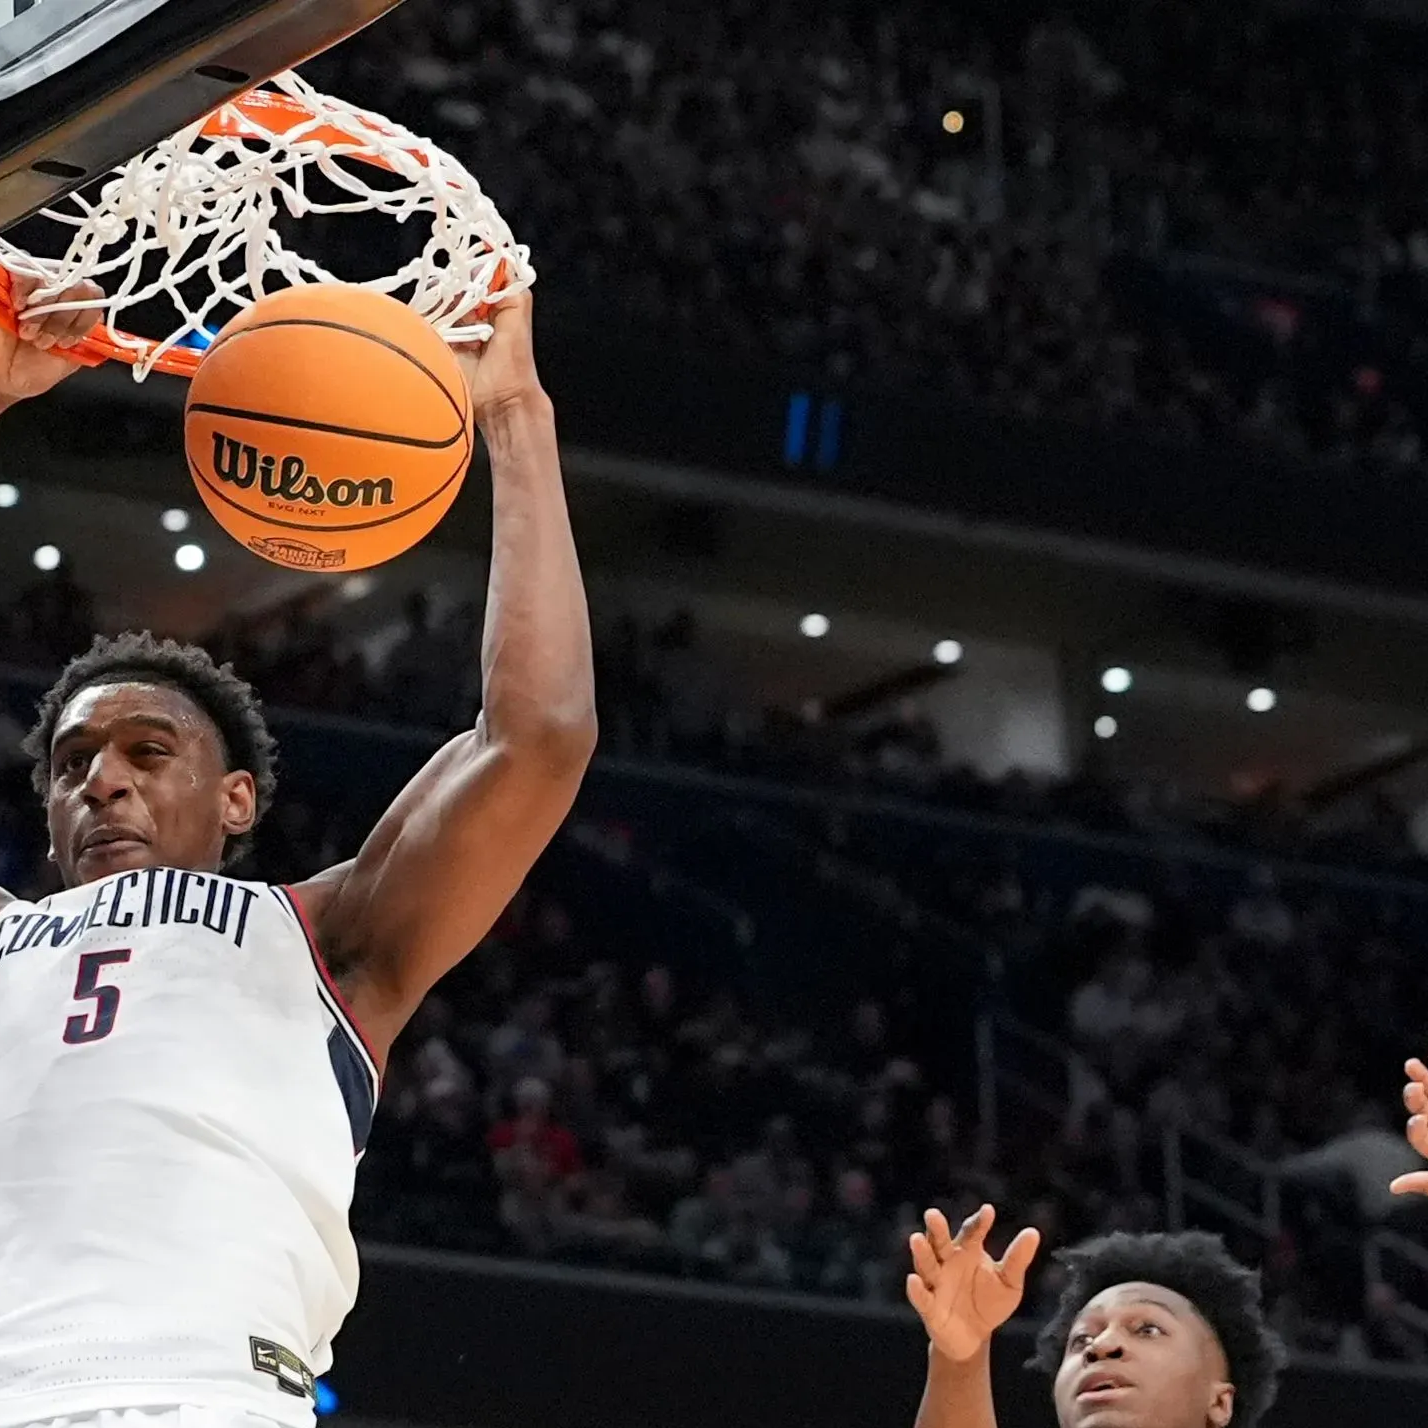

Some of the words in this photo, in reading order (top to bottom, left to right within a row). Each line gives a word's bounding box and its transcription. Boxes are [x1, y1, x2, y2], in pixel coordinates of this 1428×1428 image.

[212, 430, 395, 507] Wilson
[268, 501, 294, 513] EVO
[299, 507, 326, 516] NXT
[62, 949, 131, 1045] 5
